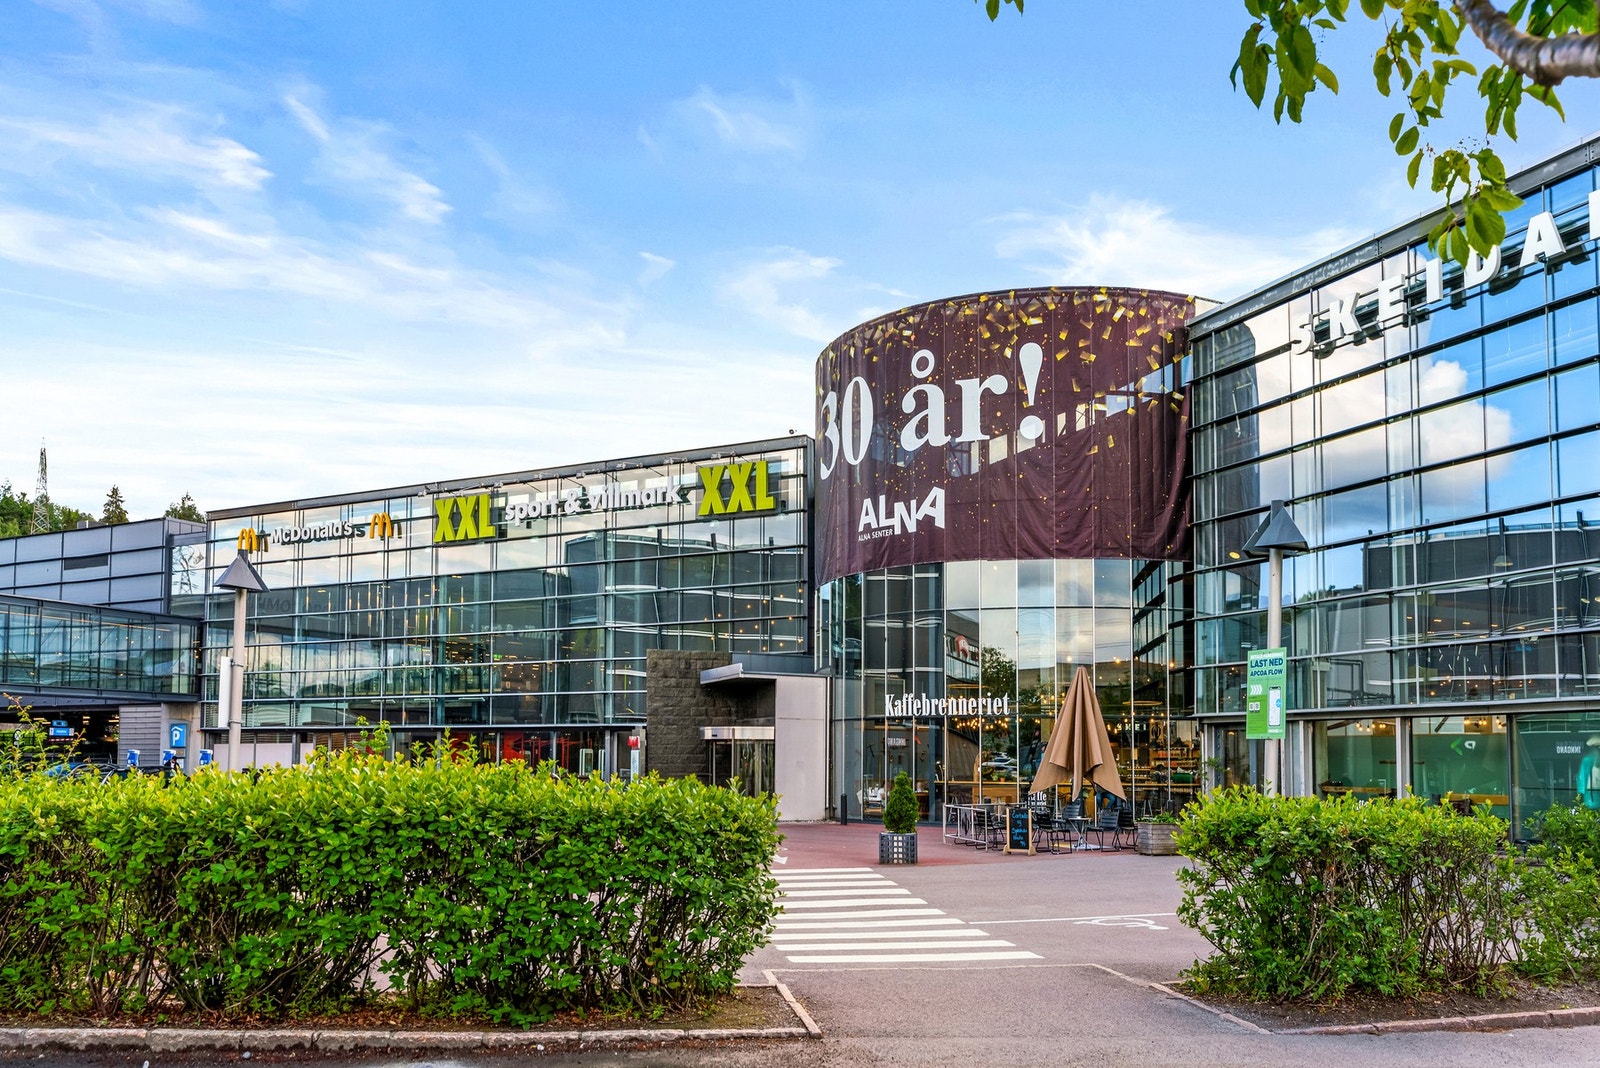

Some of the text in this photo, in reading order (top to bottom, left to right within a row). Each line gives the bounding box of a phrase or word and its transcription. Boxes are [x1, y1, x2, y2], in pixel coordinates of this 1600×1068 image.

[1291, 190, 1600, 355] SKEIDA
[820, 342, 1044, 480] 30 år!
[434, 460, 777, 543] XXL sport & villmark XXL
[858, 486, 945, 535] ALNA
[271, 521, 353, 544] McDonald's
[858, 529, 893, 541] ALNA SENTER
[1250, 658, 1283, 668] LAST NED
[885, 692, 1010, 717] Kaffebrenneriet
